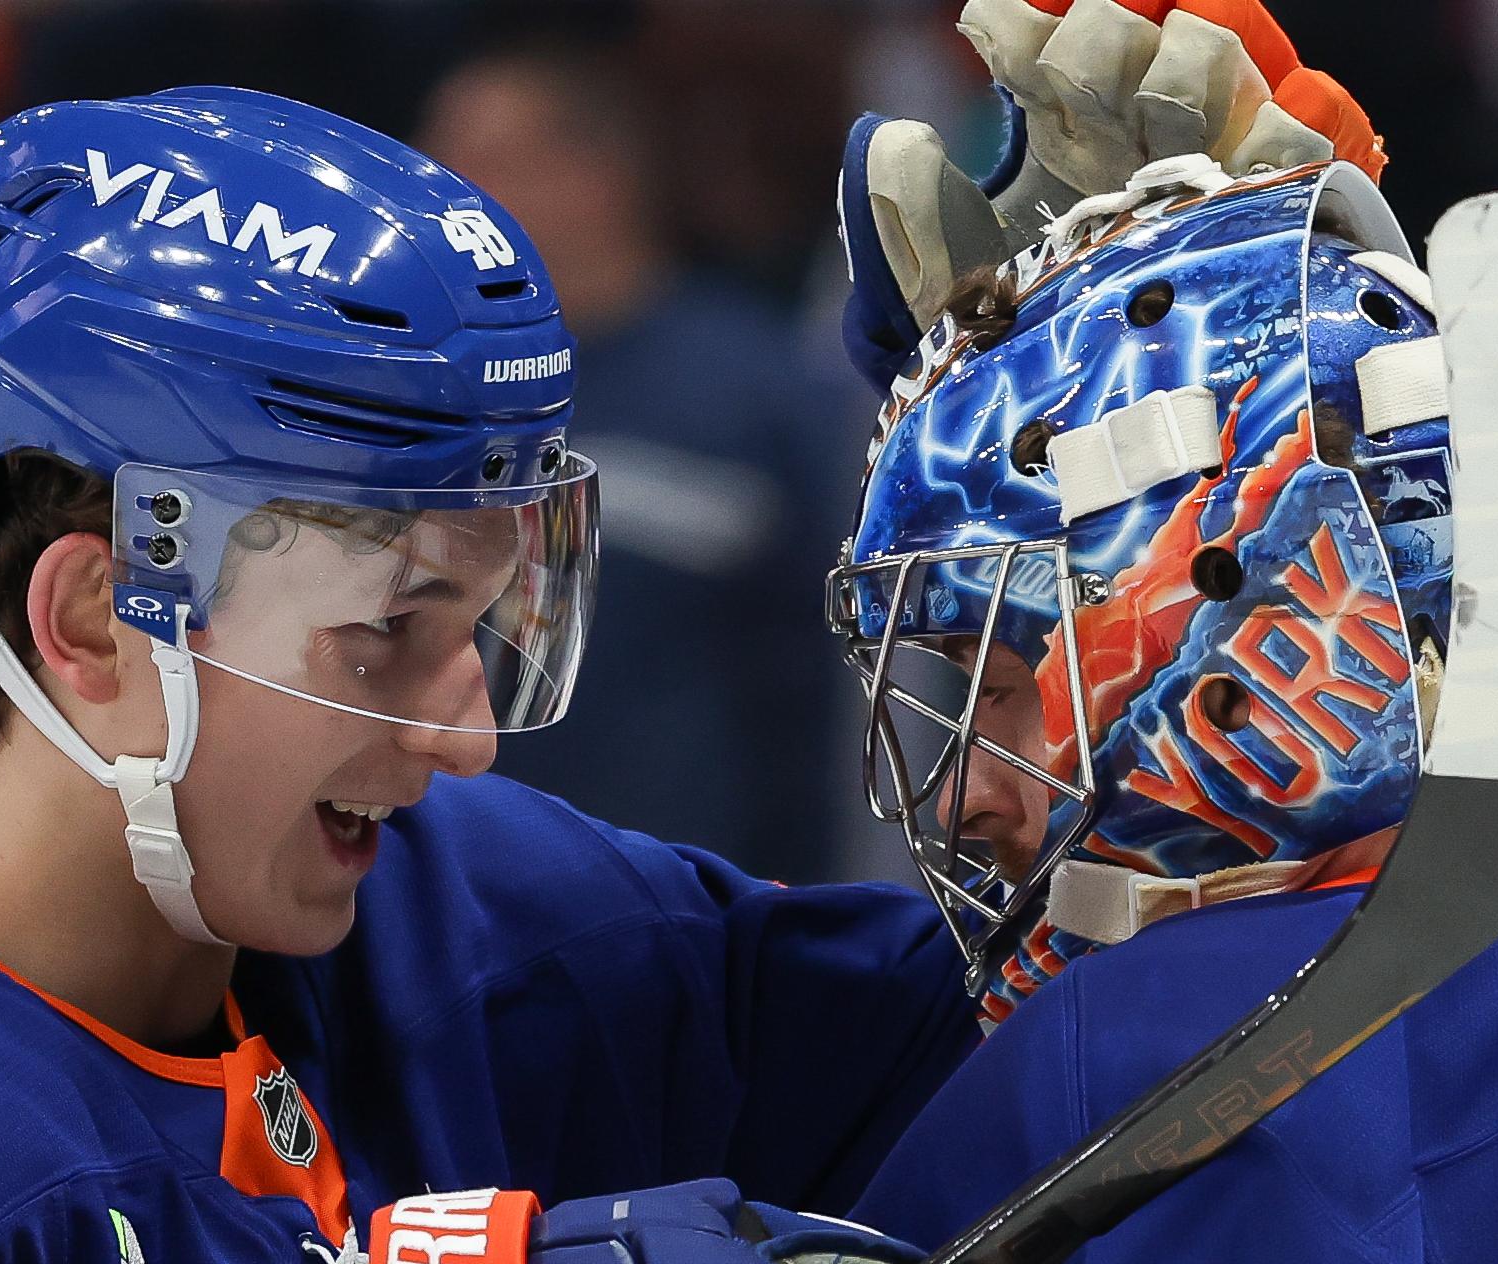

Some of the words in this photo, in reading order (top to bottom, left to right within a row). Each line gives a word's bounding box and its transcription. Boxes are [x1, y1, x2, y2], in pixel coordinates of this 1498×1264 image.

[85, 148, 337, 277] VIAM
[441, 209, 516, 271] 48
[483, 348, 571, 383] WARRIOR
[118, 607, 171, 623] OAKLEY
[1125, 520, 1412, 860] YORK
[278, 1094, 297, 1150] NHL
[1099, 1028, 1314, 1184] ERT
